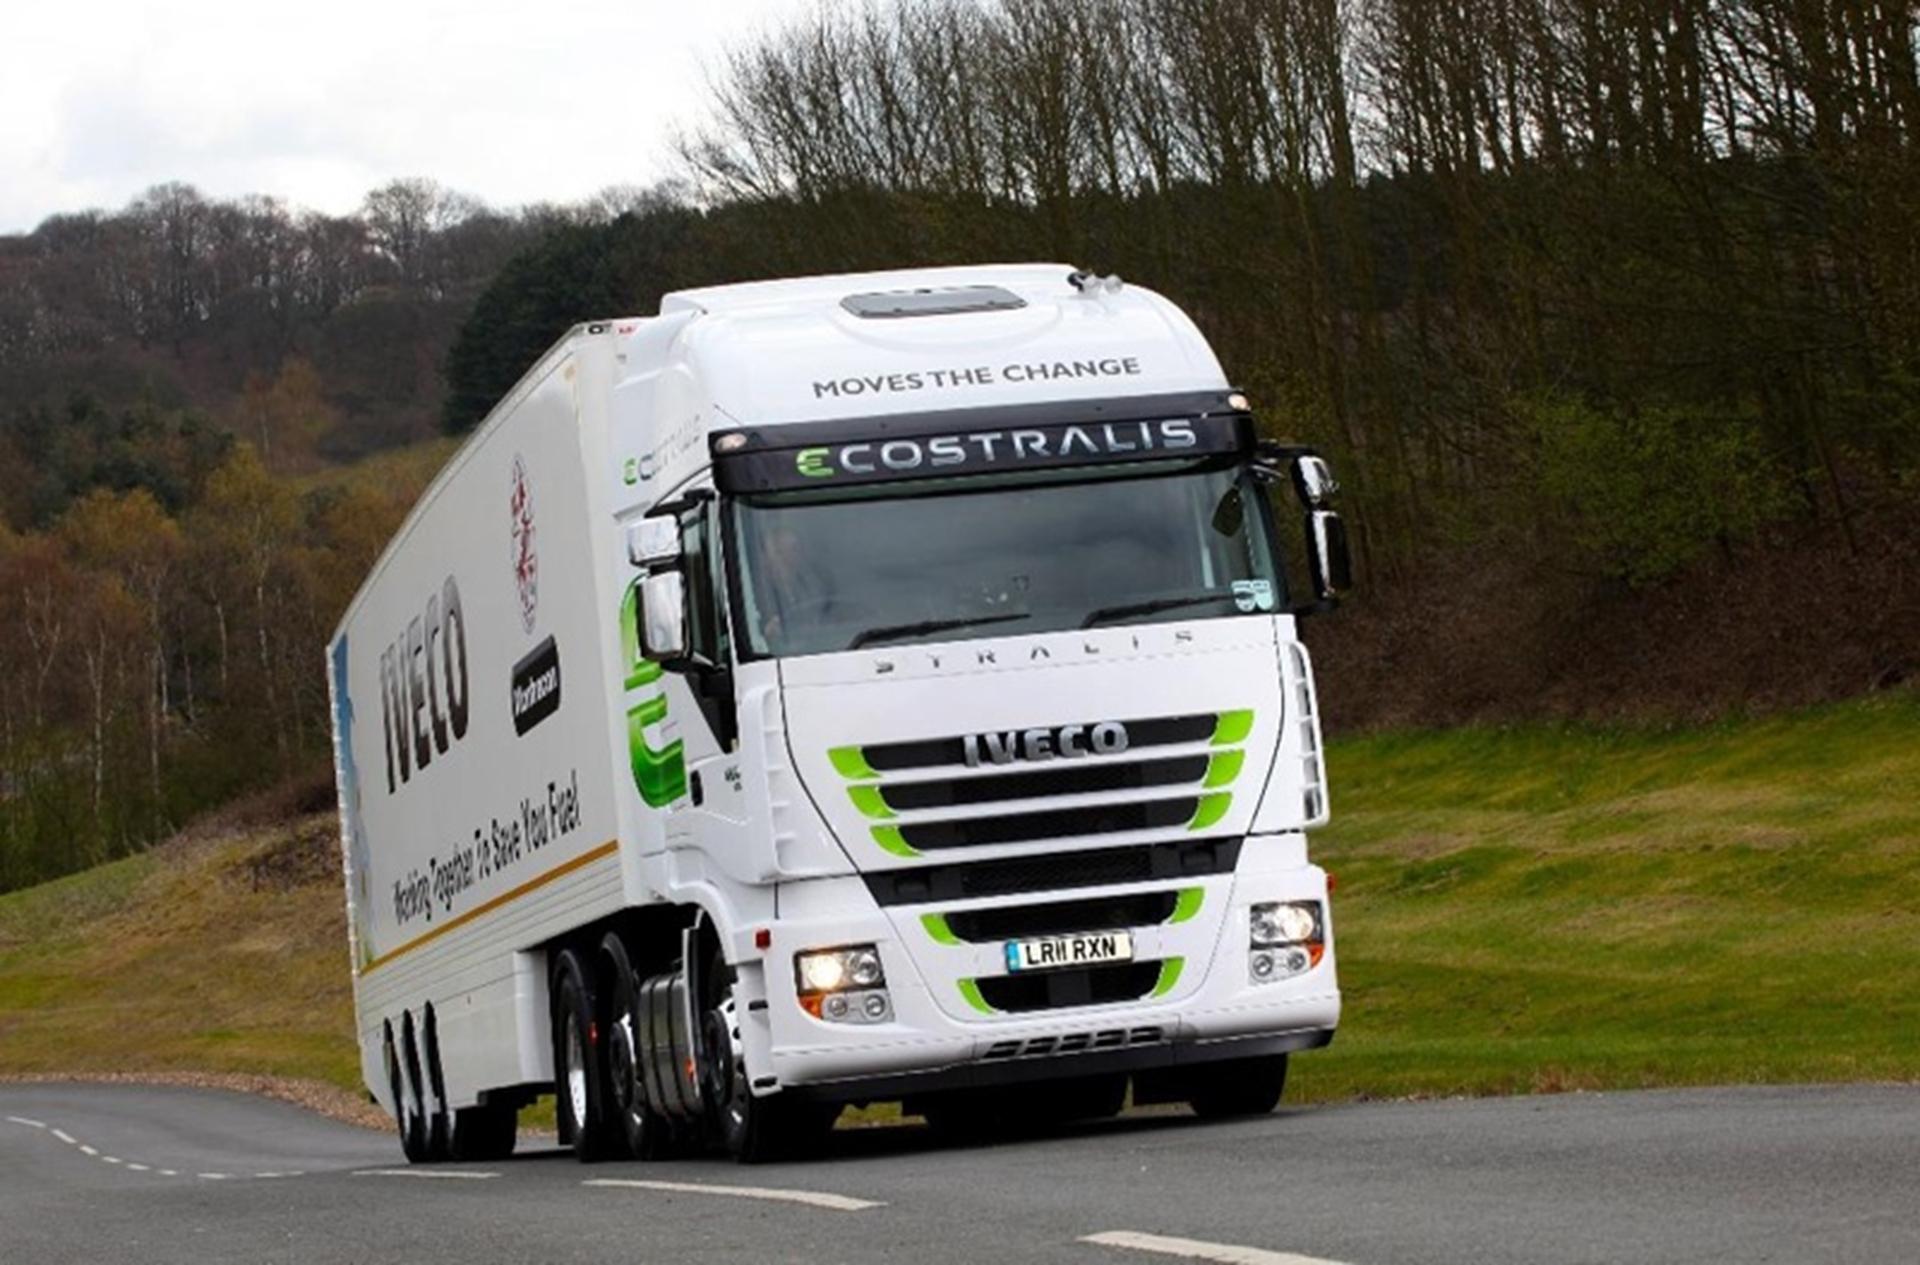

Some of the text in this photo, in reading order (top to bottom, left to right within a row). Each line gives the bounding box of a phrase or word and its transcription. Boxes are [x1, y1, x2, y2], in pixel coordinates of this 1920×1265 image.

[812, 357, 1142, 399] MOVES THE CHANGE
[796, 418, 1196, 479] ECOSTRALIS
[875, 631, 1193, 674] STRALIS
[379, 573, 469, 795] IVECO
[963, 721, 1129, 768] IVECO
[474, 829, 491, 879] To
[491, 819, 520, 872] Save
[520, 798, 548, 853] You
[548, 768, 581, 840] Fuel
[1025, 936, 1116, 965] LR11 RXN
